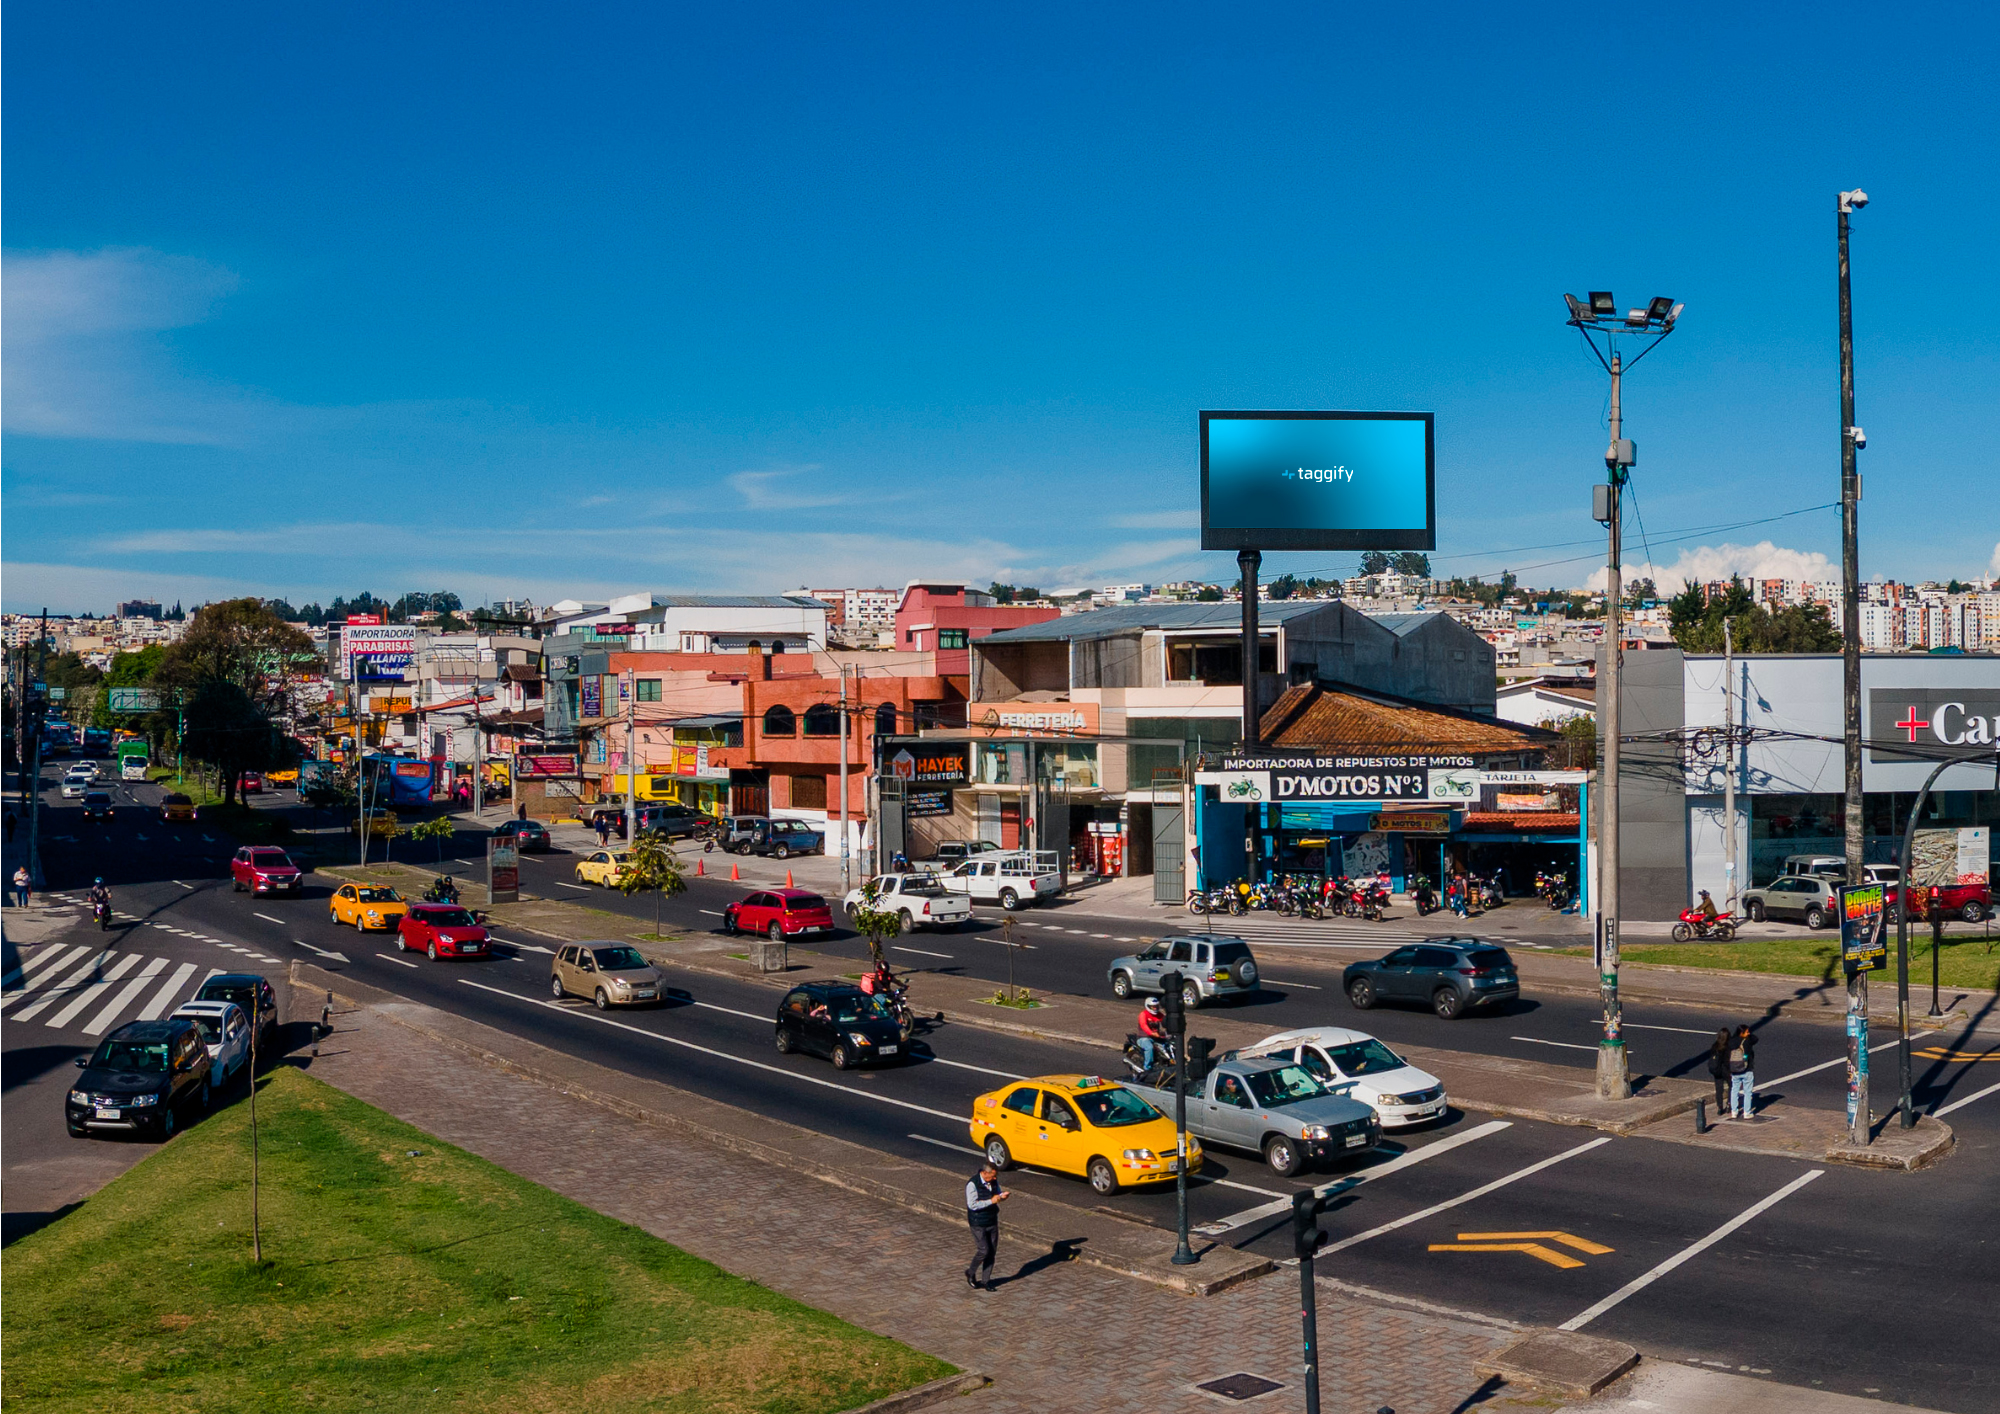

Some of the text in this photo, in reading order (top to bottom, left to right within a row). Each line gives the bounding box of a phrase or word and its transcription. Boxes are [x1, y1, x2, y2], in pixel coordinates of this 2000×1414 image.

[1297, 465, 1354, 483] taggify
[350, 629, 415, 639] IMPORTADORA
[350, 641, 415, 652] PARABRISAS
[999, 708, 1087, 729] FERRETERÍA
[917, 757, 964, 773] HAYEK
[1224, 756, 1475, 770] IMPORTADORA DE REPUESTOS DE MOTOS
[917, 770, 965, 781] FERRETERÍA
[1277, 775, 1381, 796] D'MOTOS
[1845, 887, 1882, 907] DAMAS
[1846, 898, 1882, 920] GRATIS
